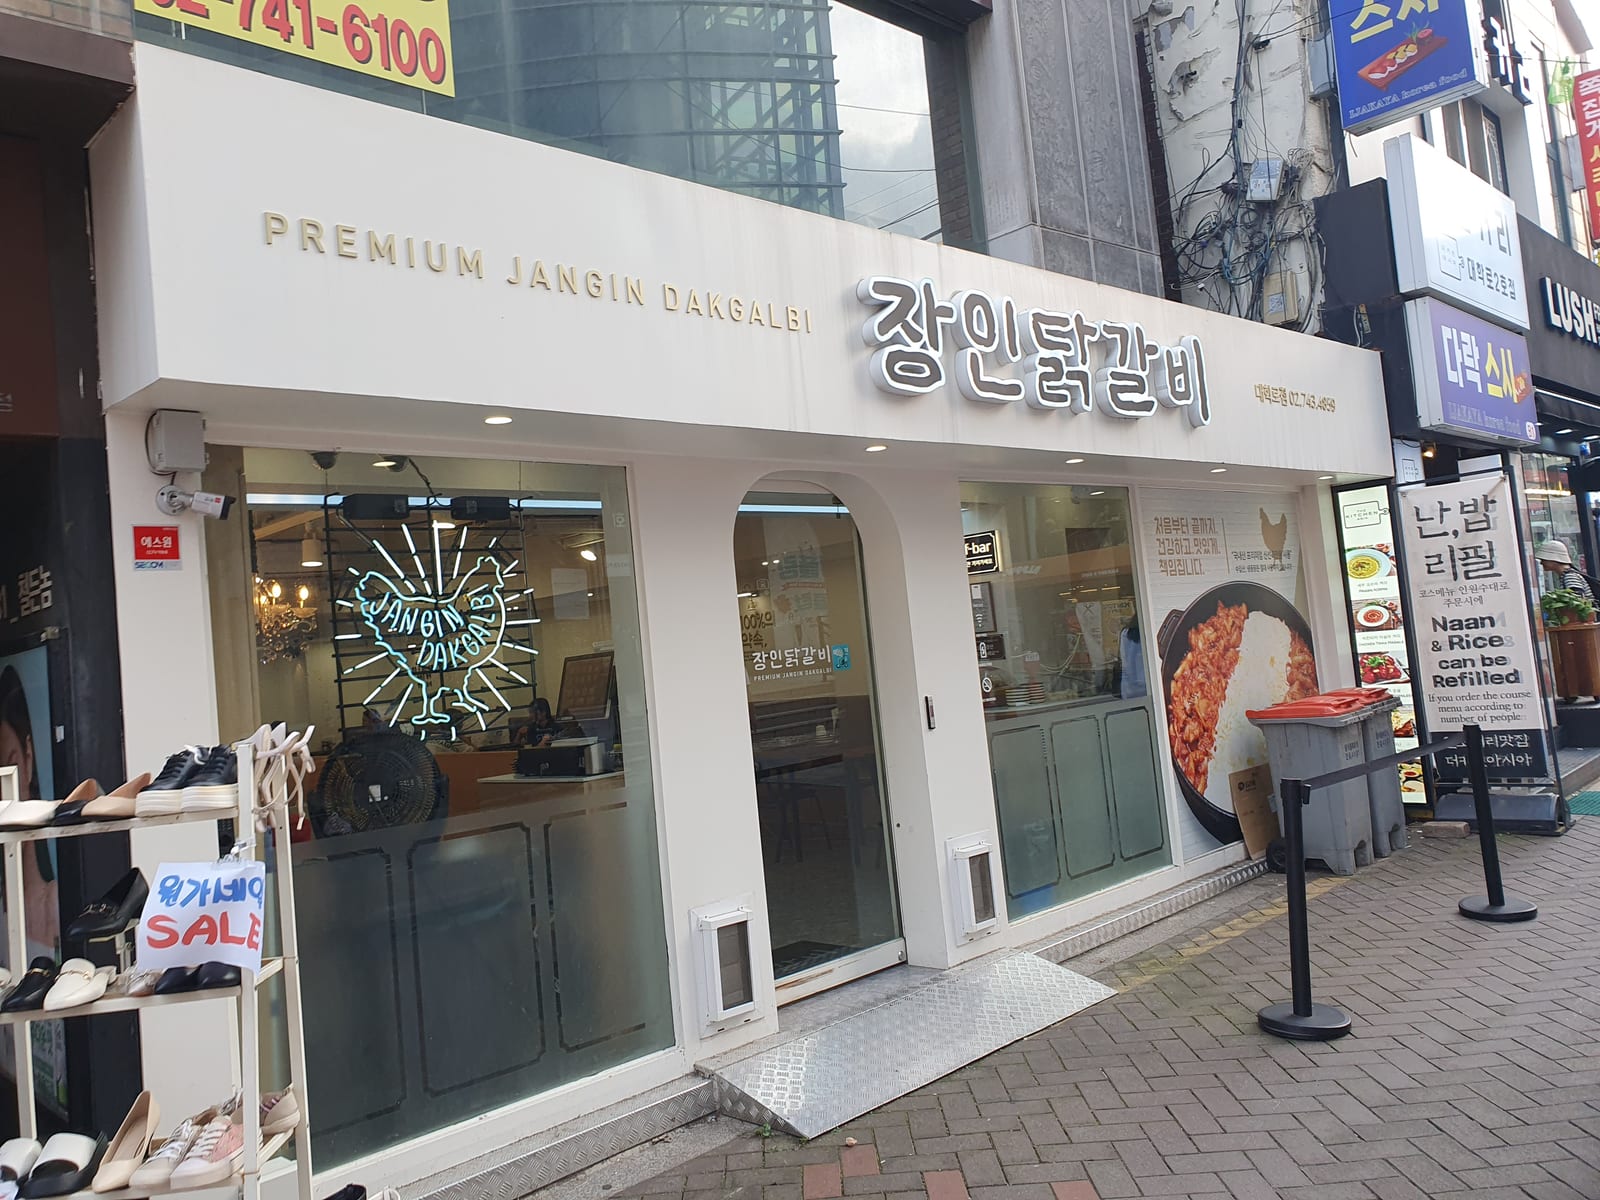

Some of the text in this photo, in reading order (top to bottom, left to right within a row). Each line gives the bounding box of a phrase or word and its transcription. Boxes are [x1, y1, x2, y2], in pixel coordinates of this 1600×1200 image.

[263, 209, 813, 334] PREMIUM JANGIN DAKGALBI
[1545, 276, 1598, 344] LUSH
[860, 277, 1212, 427] 장인닭갈비
[1440, 325, 1483, 394] 다락
[1154, 516, 1189, 534] 처음부터
[141, 536, 172, 548] 에스원
[1424, 540, 1503, 582] 리필
[1419, 587, 1456, 598] 코스메뉴
[368, 590, 465, 639] JANGIN
[1431, 615, 1496, 632] Naan
[416, 583, 497, 671] DAKGALBI
[1431, 634, 1505, 652] & Rice
[752, 644, 831, 671] 장인닭갈비
[1438, 654, 1508, 670] can be
[753, 672, 781, 681] PREMIUM
[782, 670, 803, 679] JANGIN
[1432, 668, 1521, 688] Refilled
[1428, 690, 1531, 704] If you order the course
[1438, 702, 1523, 714] menu according to
[1440, 712, 1521, 723] number of people
[146, 911, 261, 952] SALE
